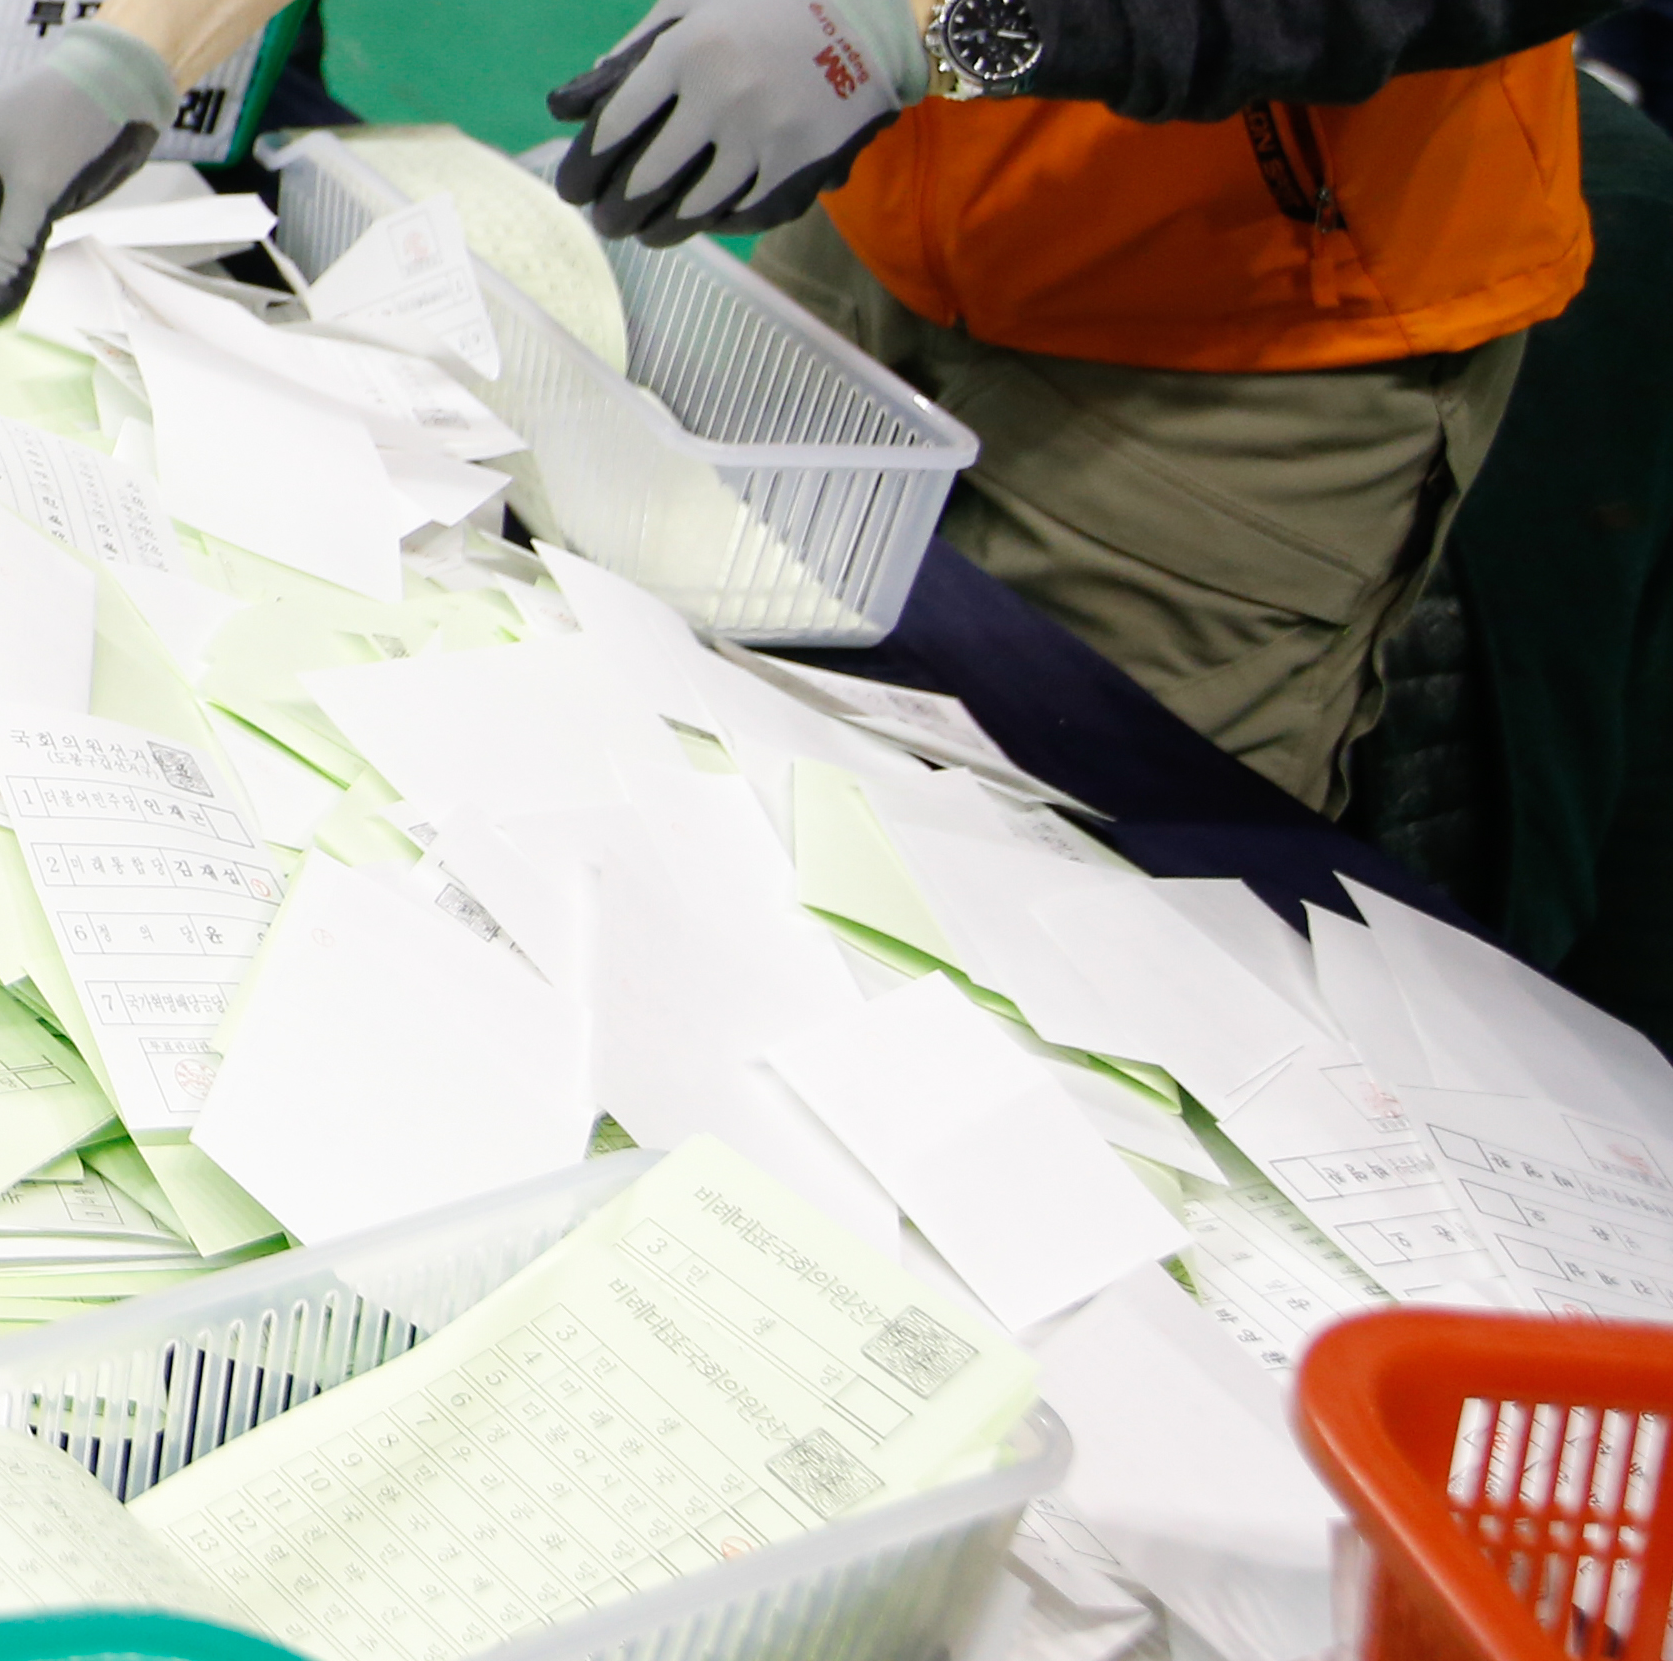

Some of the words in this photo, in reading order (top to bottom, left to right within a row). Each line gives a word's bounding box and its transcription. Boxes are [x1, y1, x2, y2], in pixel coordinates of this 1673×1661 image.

[808, 1, 836, 37] Grip
[813, 45, 856, 101] 3M
[835, 37, 870, 85] Super
[9, 728, 151, 770] 국회의원선거
[47, 750, 160, 781] (도봉구갑선거구)
[21, 789, 34, 806] 1
[44, 789, 138, 813] 더불어민주당
[143, 798, 207, 827] 인재근
[46, 855, 60, 874] 2
[69, 855, 167, 877] 미래통합당
[173, 859, 242, 886] 김재섭
[73, 924, 88, 942] 6
[98, 922, 195, 944] 정의당
[101, 994, 114, 1012] 7
[125, 992, 226, 1014] 국가혁명배당금당
[1562, 1261, 1651, 1297] 김재섭
[646, 1237, 668, 1256] 3
[685, 1264, 841, 1386] 민생당
[555, 1324, 578, 1343] 3
[592, 1355, 745, 1495] 민생당
[485, 1369, 509, 1386] 5
[520, 1400, 672, 1539] 더불어시민당
[522, 1351, 543, 1366] 4
[558, 1378, 709, 1517] 미래한국당
[261, 1486, 294, 1514] 11
[414, 1410, 440, 1428] 7
[452, 1443, 599, 1584] 우리공화당
[450, 1391, 473, 1407] 6
[484, 1421, 635, 1564] 정의당
[187, 1527, 221, 1554] 13
[224, 1506, 258, 1534] 12
[340, 1452, 365, 1470] 9
[376, 1483, 526, 1626] 한국경제당
[377, 1432, 401, 1452] 8
[411, 1462, 563, 1606] 민중당
[299, 1467, 332, 1494] 10
[341, 1502, 488, 1646] 국민의당
